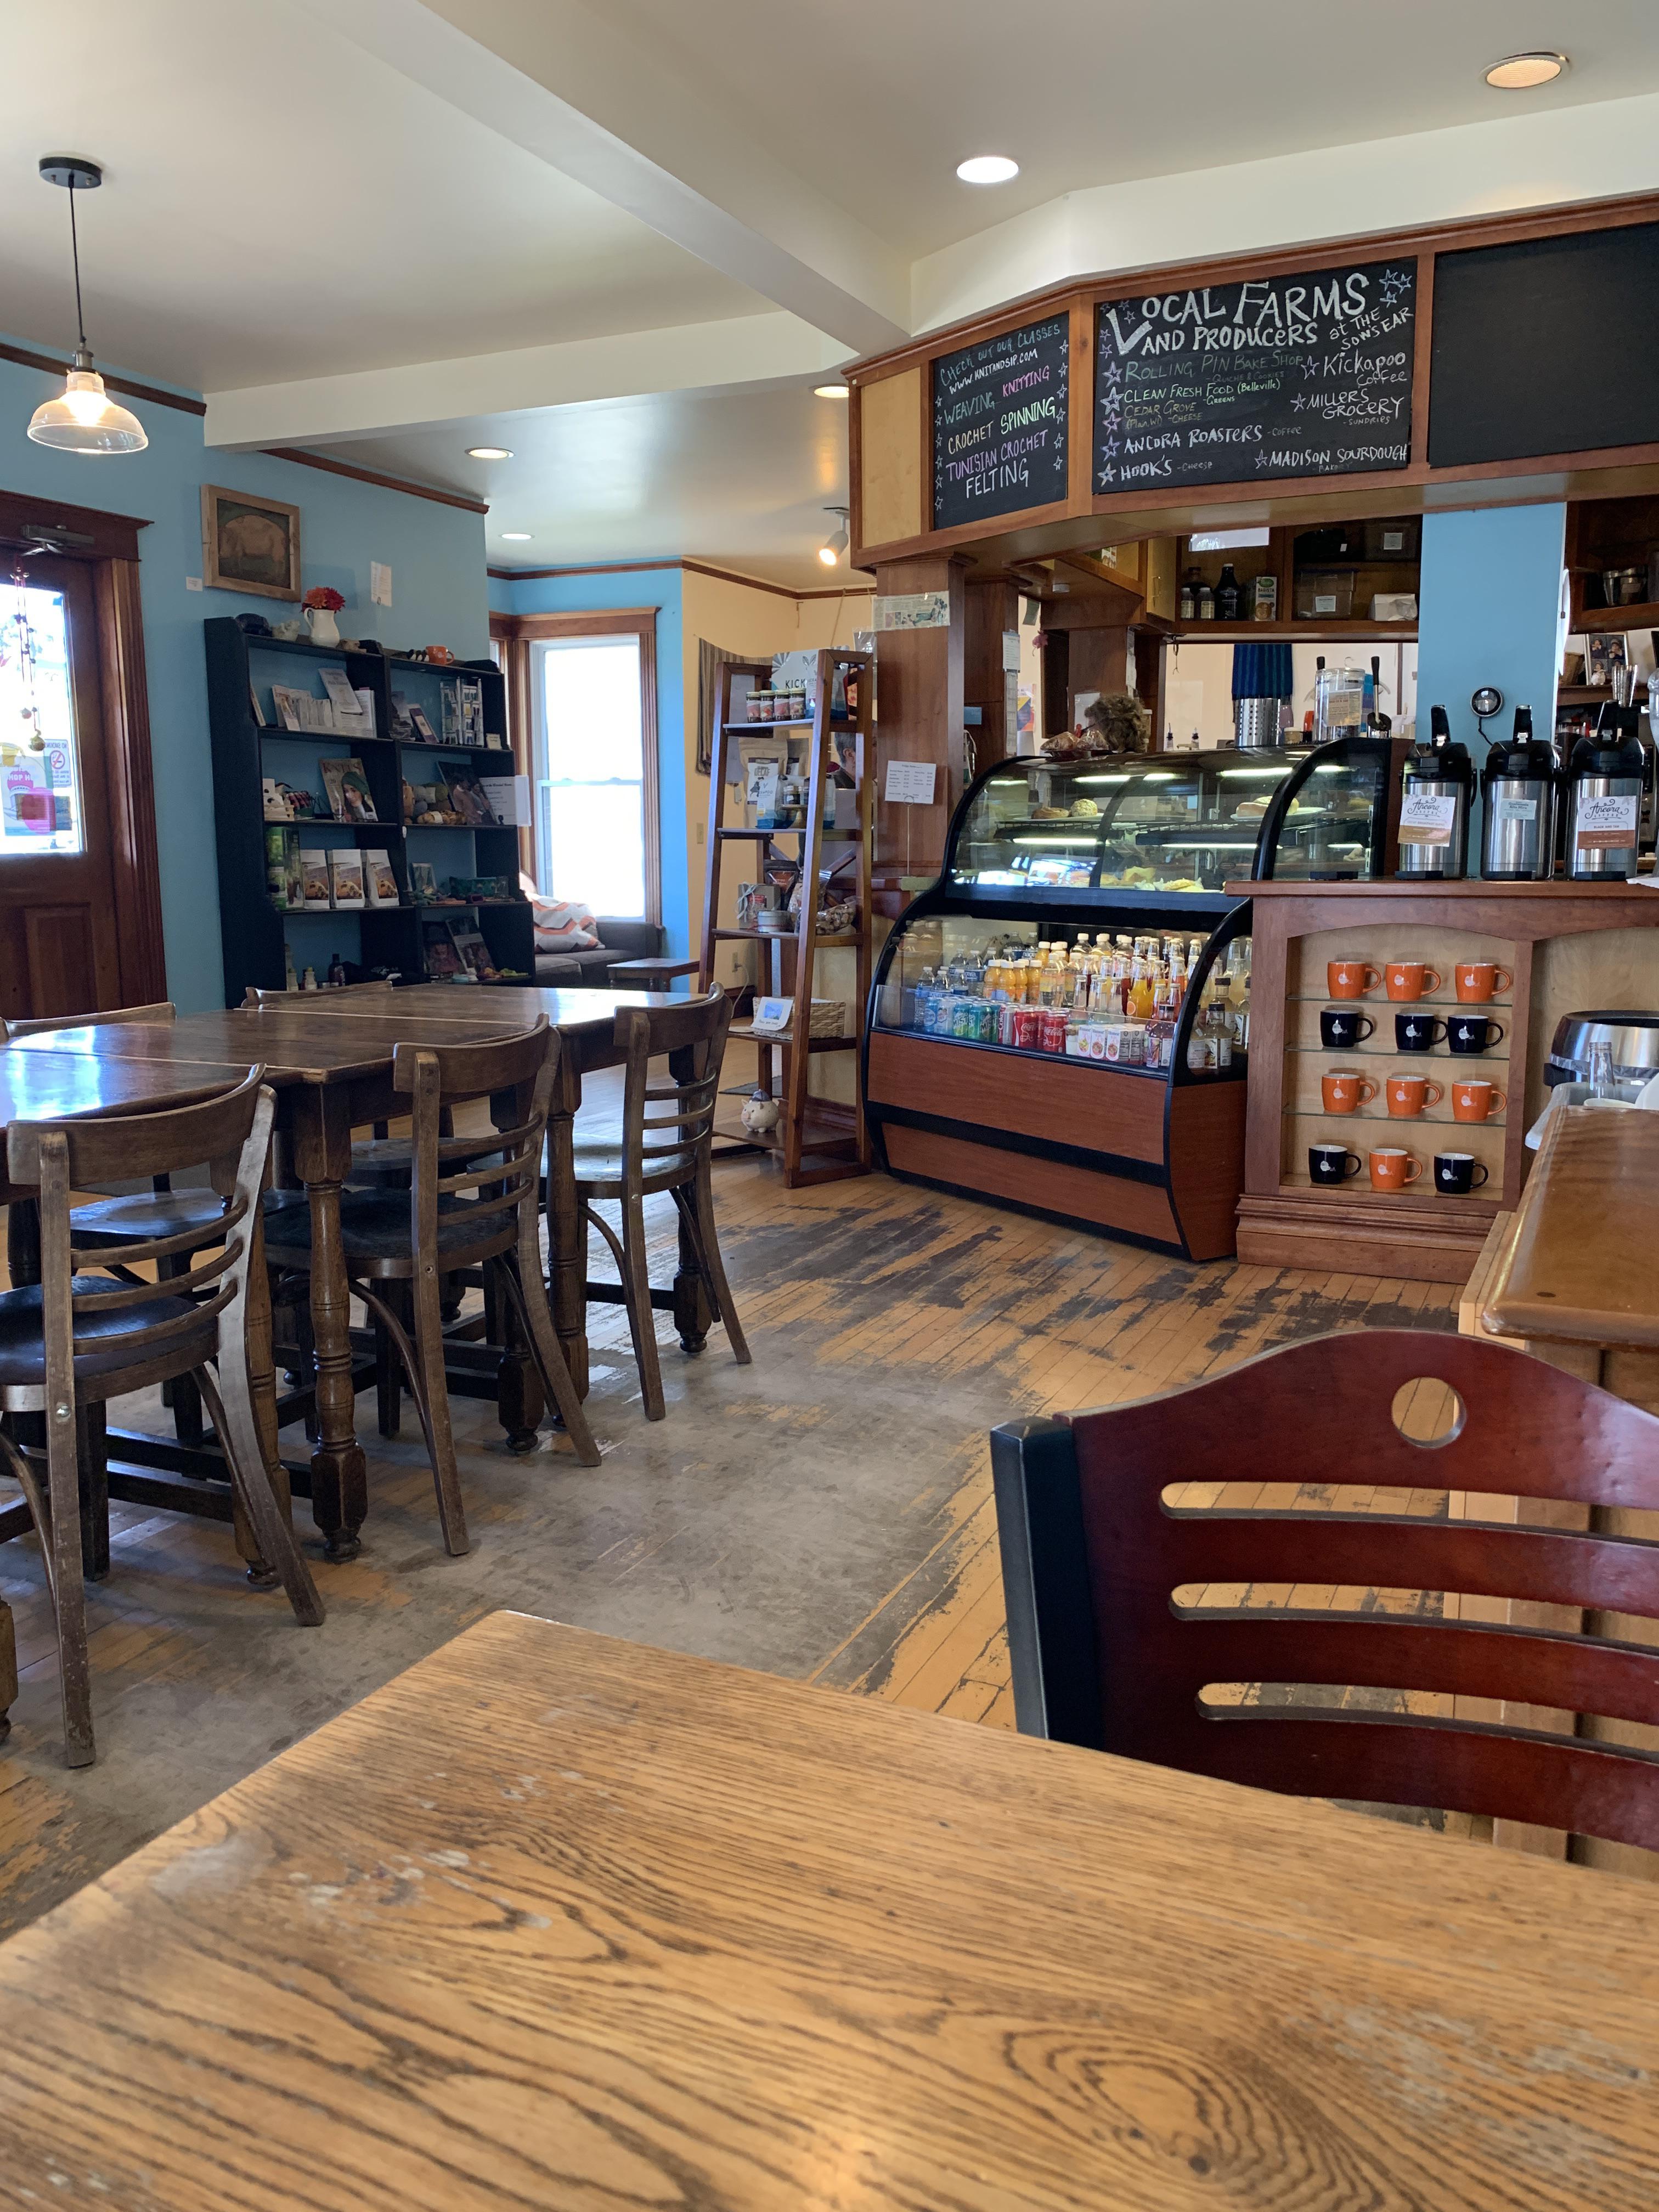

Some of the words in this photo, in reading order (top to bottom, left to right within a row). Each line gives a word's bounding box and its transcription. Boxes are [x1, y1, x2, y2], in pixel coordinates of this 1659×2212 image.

[1107, 288, 1226, 356] LOCAL
[1233, 273, 1369, 328] FARMS
[1350, 306, 1380, 329] THE
[1380, 307, 1414, 332] EAR
[940, 355, 974, 386] CHECK
[978, 345, 995, 361] OUT
[997, 337, 1012, 353] OUR
[1018, 324, 1060, 348] CLASSES
[1141, 330, 1184, 356] AND
[1125, 361, 1194, 382] ROLLING
[1201, 354, 1230, 373] PIN
[1234, 355, 1268, 371] BAKE
[1271, 350, 1304, 367] SHOP
[1323, 349, 1406, 377] Kickapoo
[1002, 365, 1049, 397] KNITTING
[1124, 388, 1167, 403] CLEAN
[1169, 383, 1203, 398] FRESH
[1205, 382, 1234, 397] FOOD
[944, 391, 996, 425] WEAVING
[1001, 397, 1056, 435] SPINNING
[1125, 405, 1160, 418] CEDAR
[1163, 400, 1197, 414] GROVE
[949, 420, 994, 454] CROCHET
[1124, 432, 1180, 454] ANCORA
[946, 448, 997, 481] TUNISIAN
[1001, 429, 1048, 461] CROCHET
[1269, 449, 1330, 467] MADISON
[1337, 443, 1408, 463] SOURDOUGH
[966, 458, 1029, 498] FELTING
[1408, 798, 1442, 814] Ancora
[1585, 800, 1622, 819] Ancora
